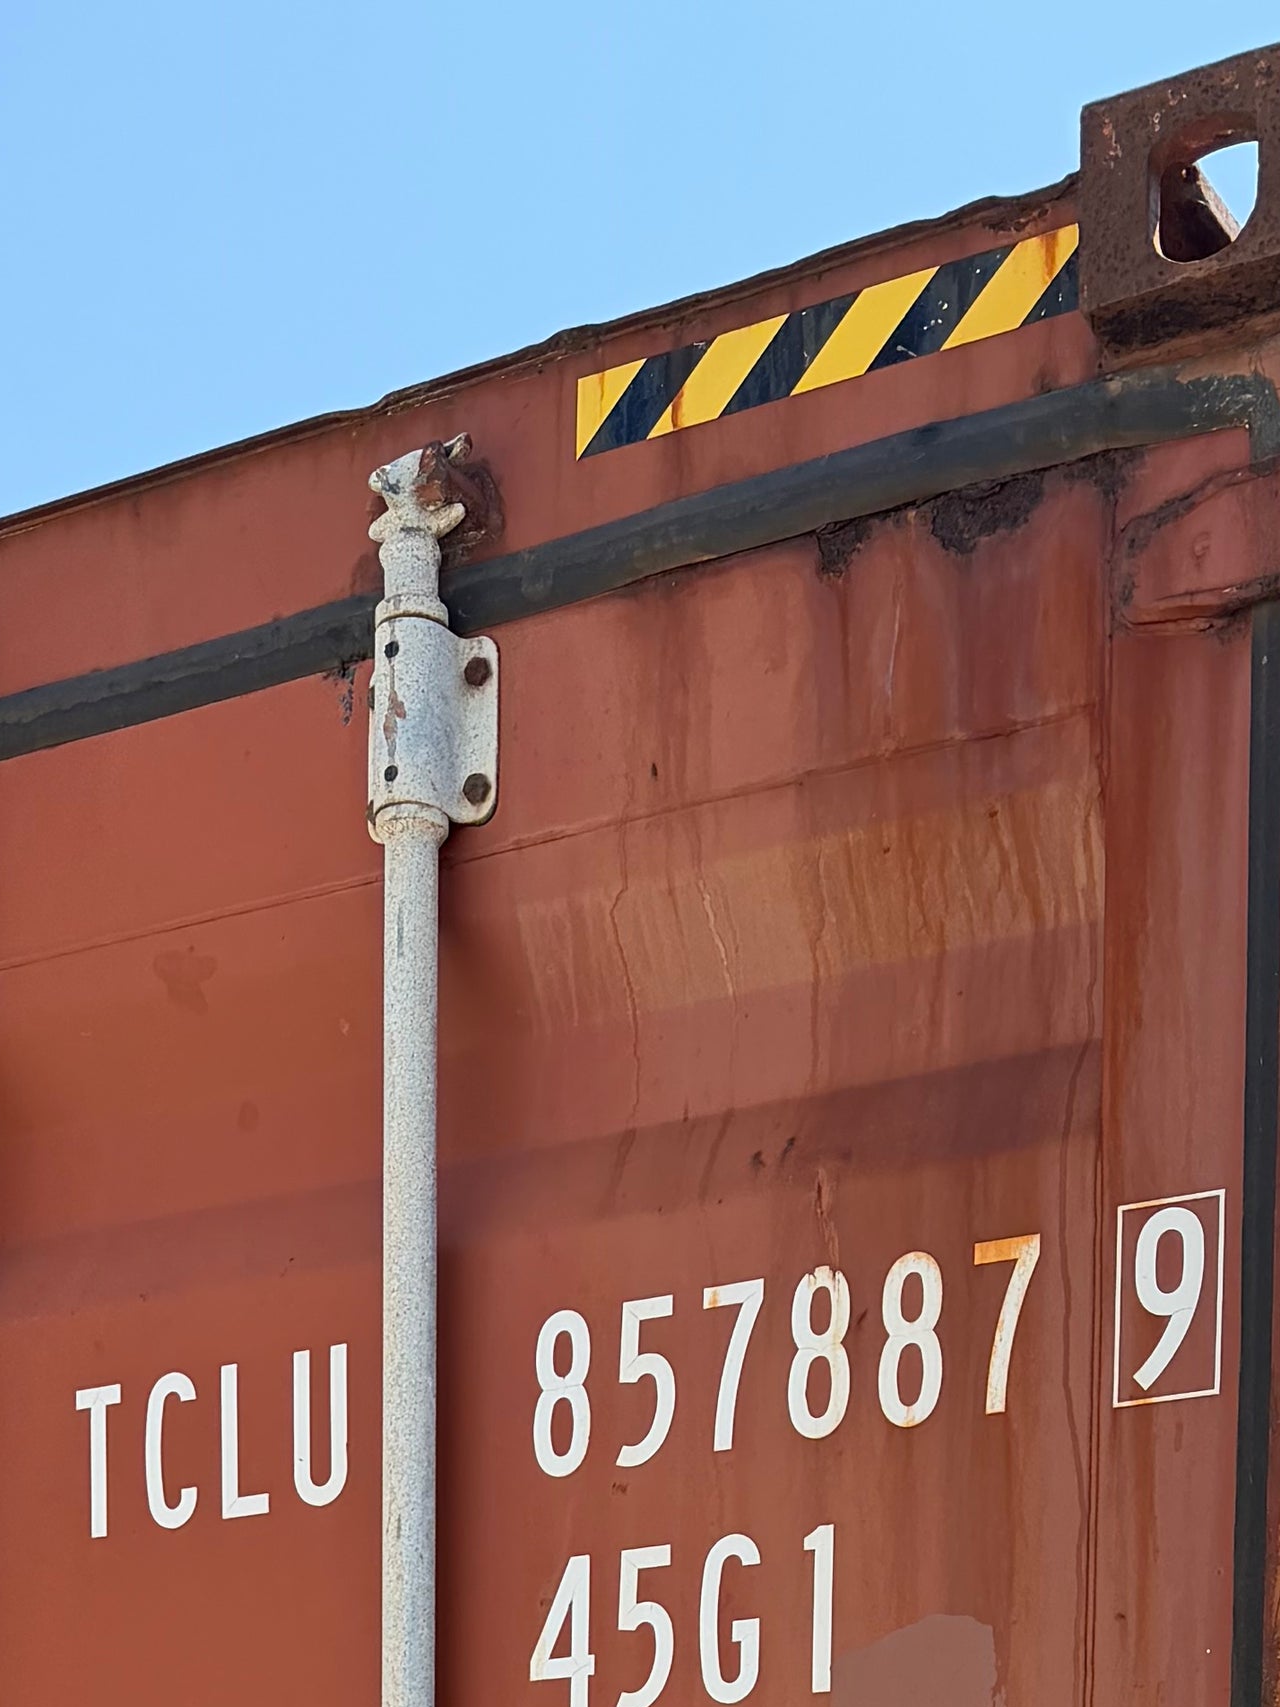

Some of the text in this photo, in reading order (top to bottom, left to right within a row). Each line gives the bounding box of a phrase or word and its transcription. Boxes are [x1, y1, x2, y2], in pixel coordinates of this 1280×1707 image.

[76, 1207, 1205, 1538] TCLU 857887 9
